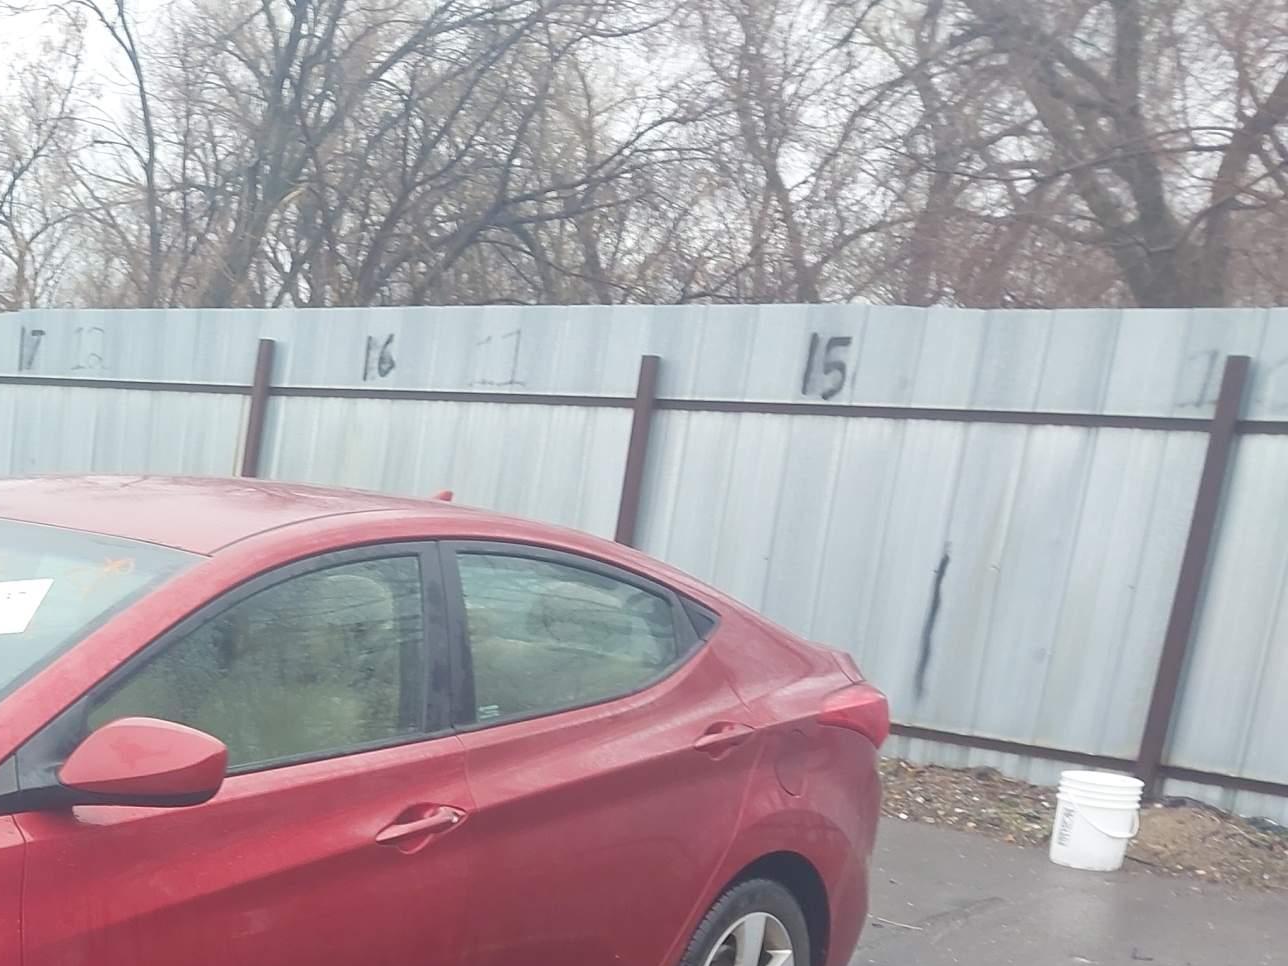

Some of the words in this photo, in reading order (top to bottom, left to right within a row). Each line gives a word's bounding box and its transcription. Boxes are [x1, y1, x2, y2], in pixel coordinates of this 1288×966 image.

[18, 326, 46, 371] 17
[363, 333, 395, 381] 16
[801, 332, 852, 400] 15
